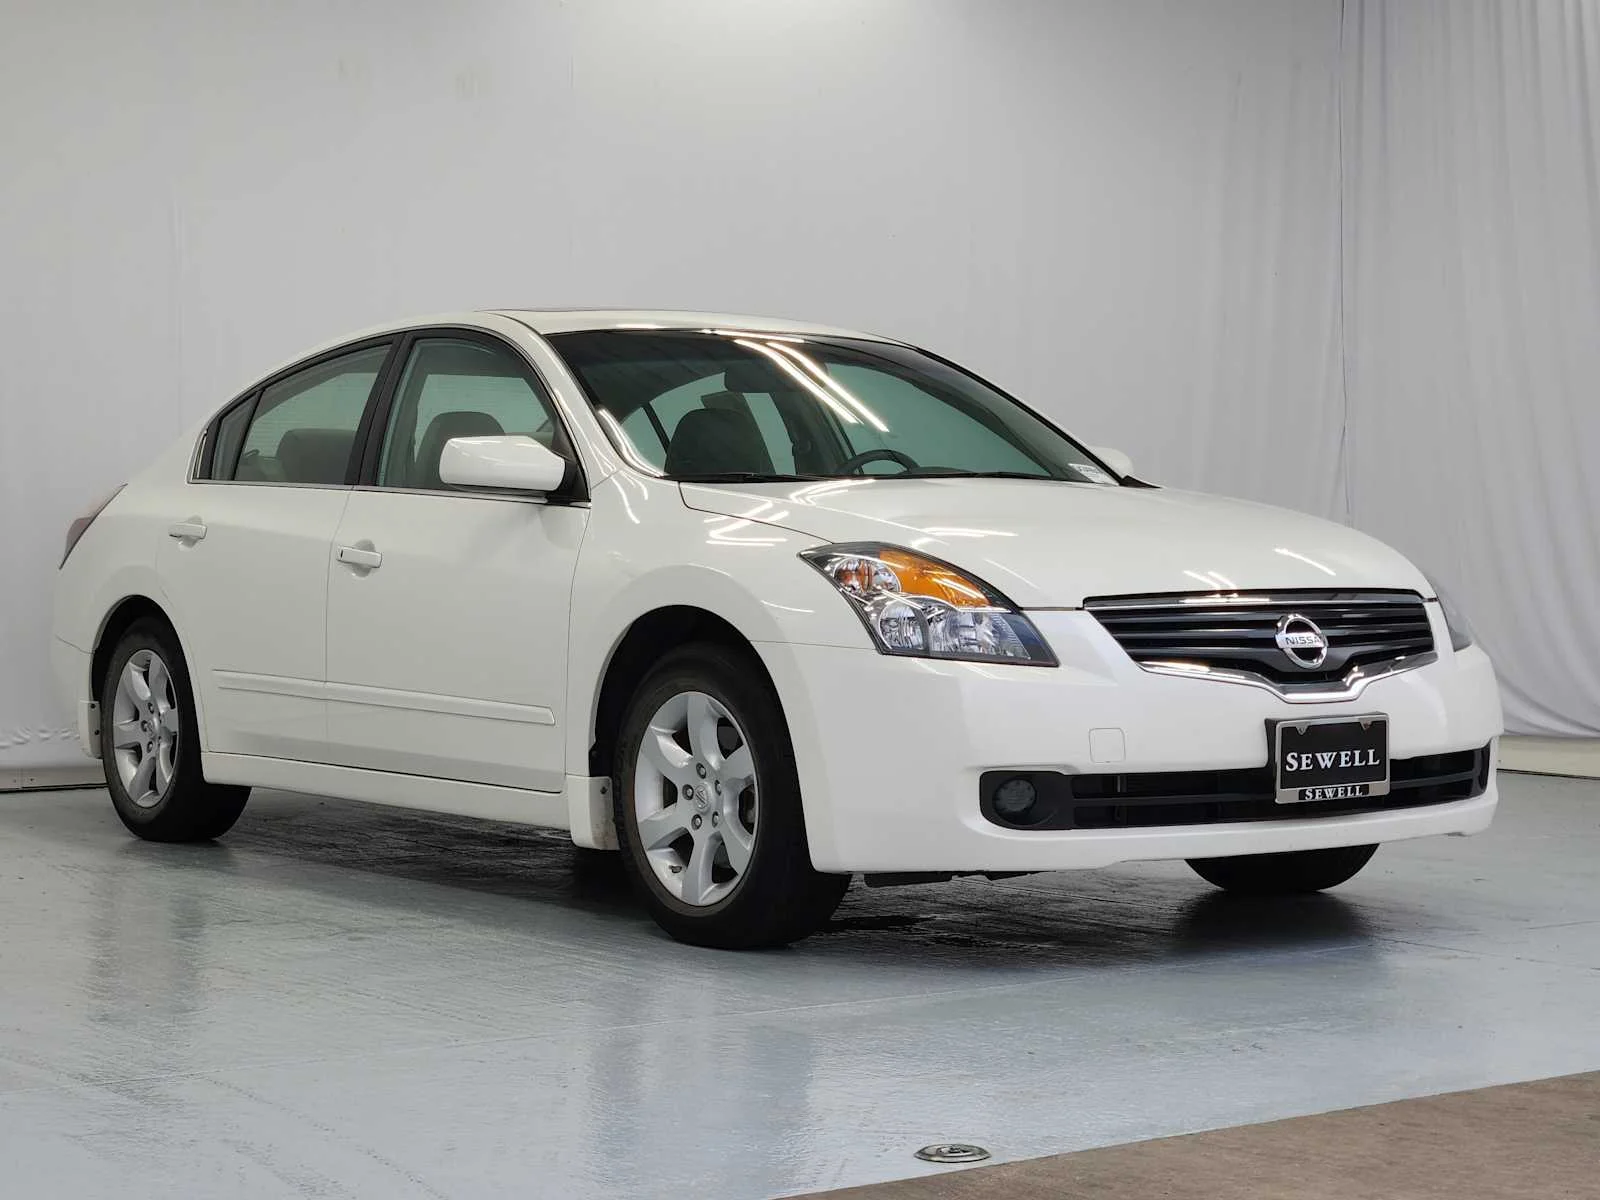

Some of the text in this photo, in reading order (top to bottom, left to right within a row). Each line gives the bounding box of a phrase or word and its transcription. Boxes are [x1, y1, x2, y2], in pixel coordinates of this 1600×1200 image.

[1285, 636, 1322, 645] NISSA
[1285, 749, 1380, 772] SEWELL
[1305, 786, 1363, 801] SEWELL
